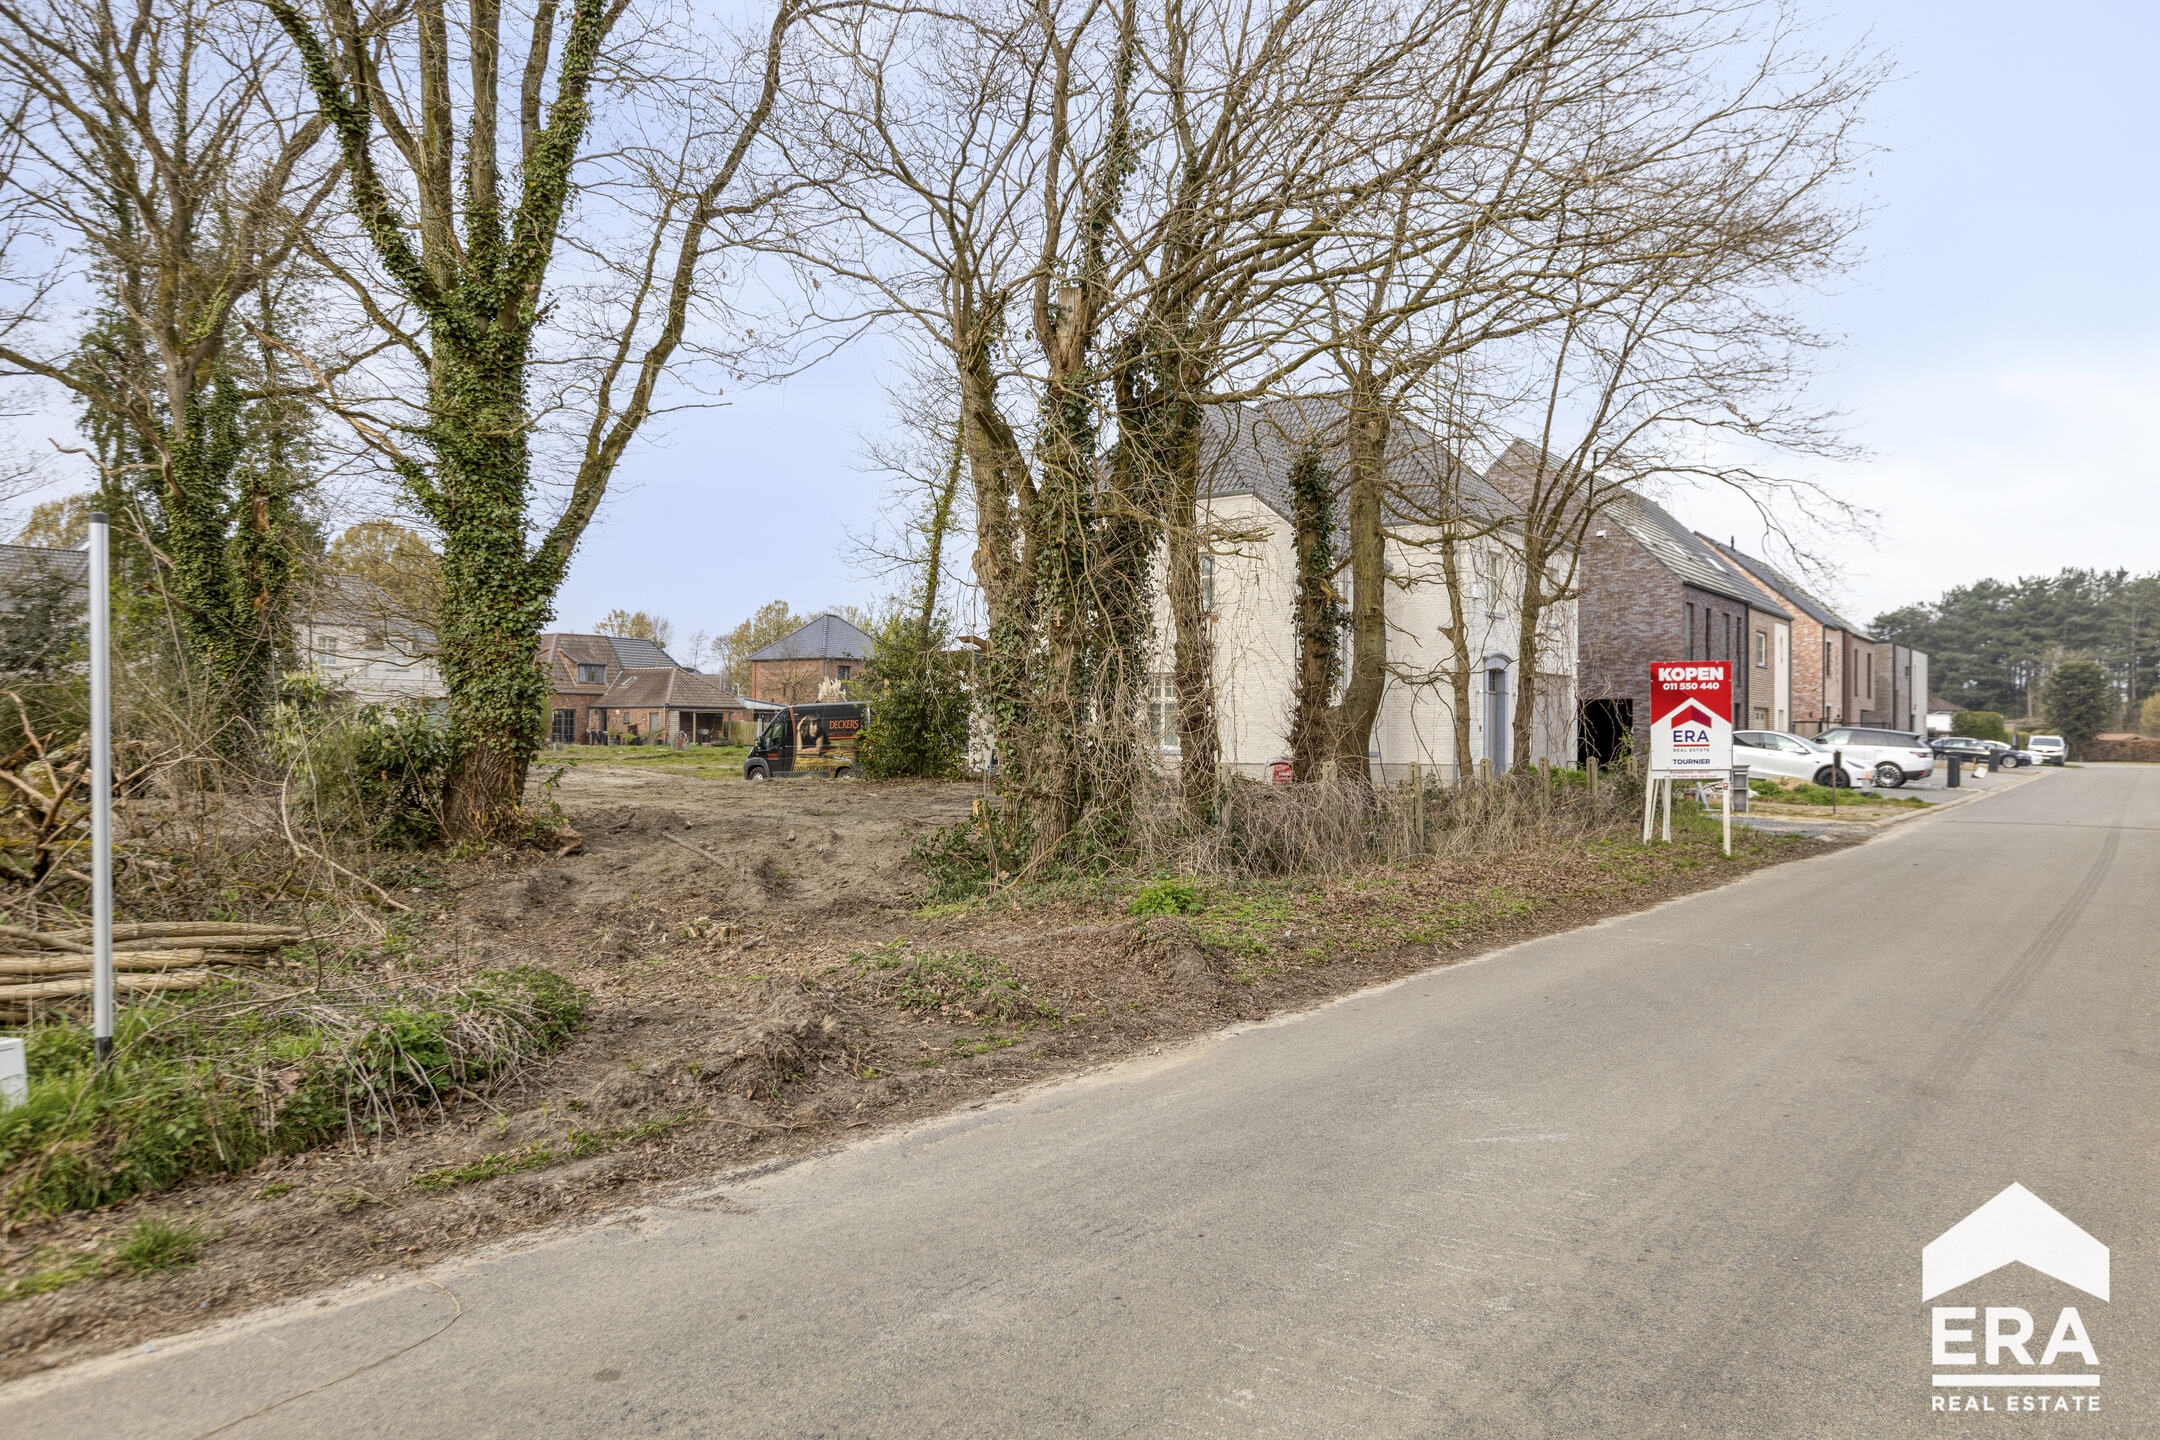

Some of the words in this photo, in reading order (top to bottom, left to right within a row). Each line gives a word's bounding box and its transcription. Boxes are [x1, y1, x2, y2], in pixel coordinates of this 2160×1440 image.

[1658, 667, 1724, 681] KOPEN
[1663, 682, 1678, 690] 011
[1700, 682, 1720, 690] 440
[829, 719, 859, 729] DECKERS
[1673, 730, 1710, 743] ERA
